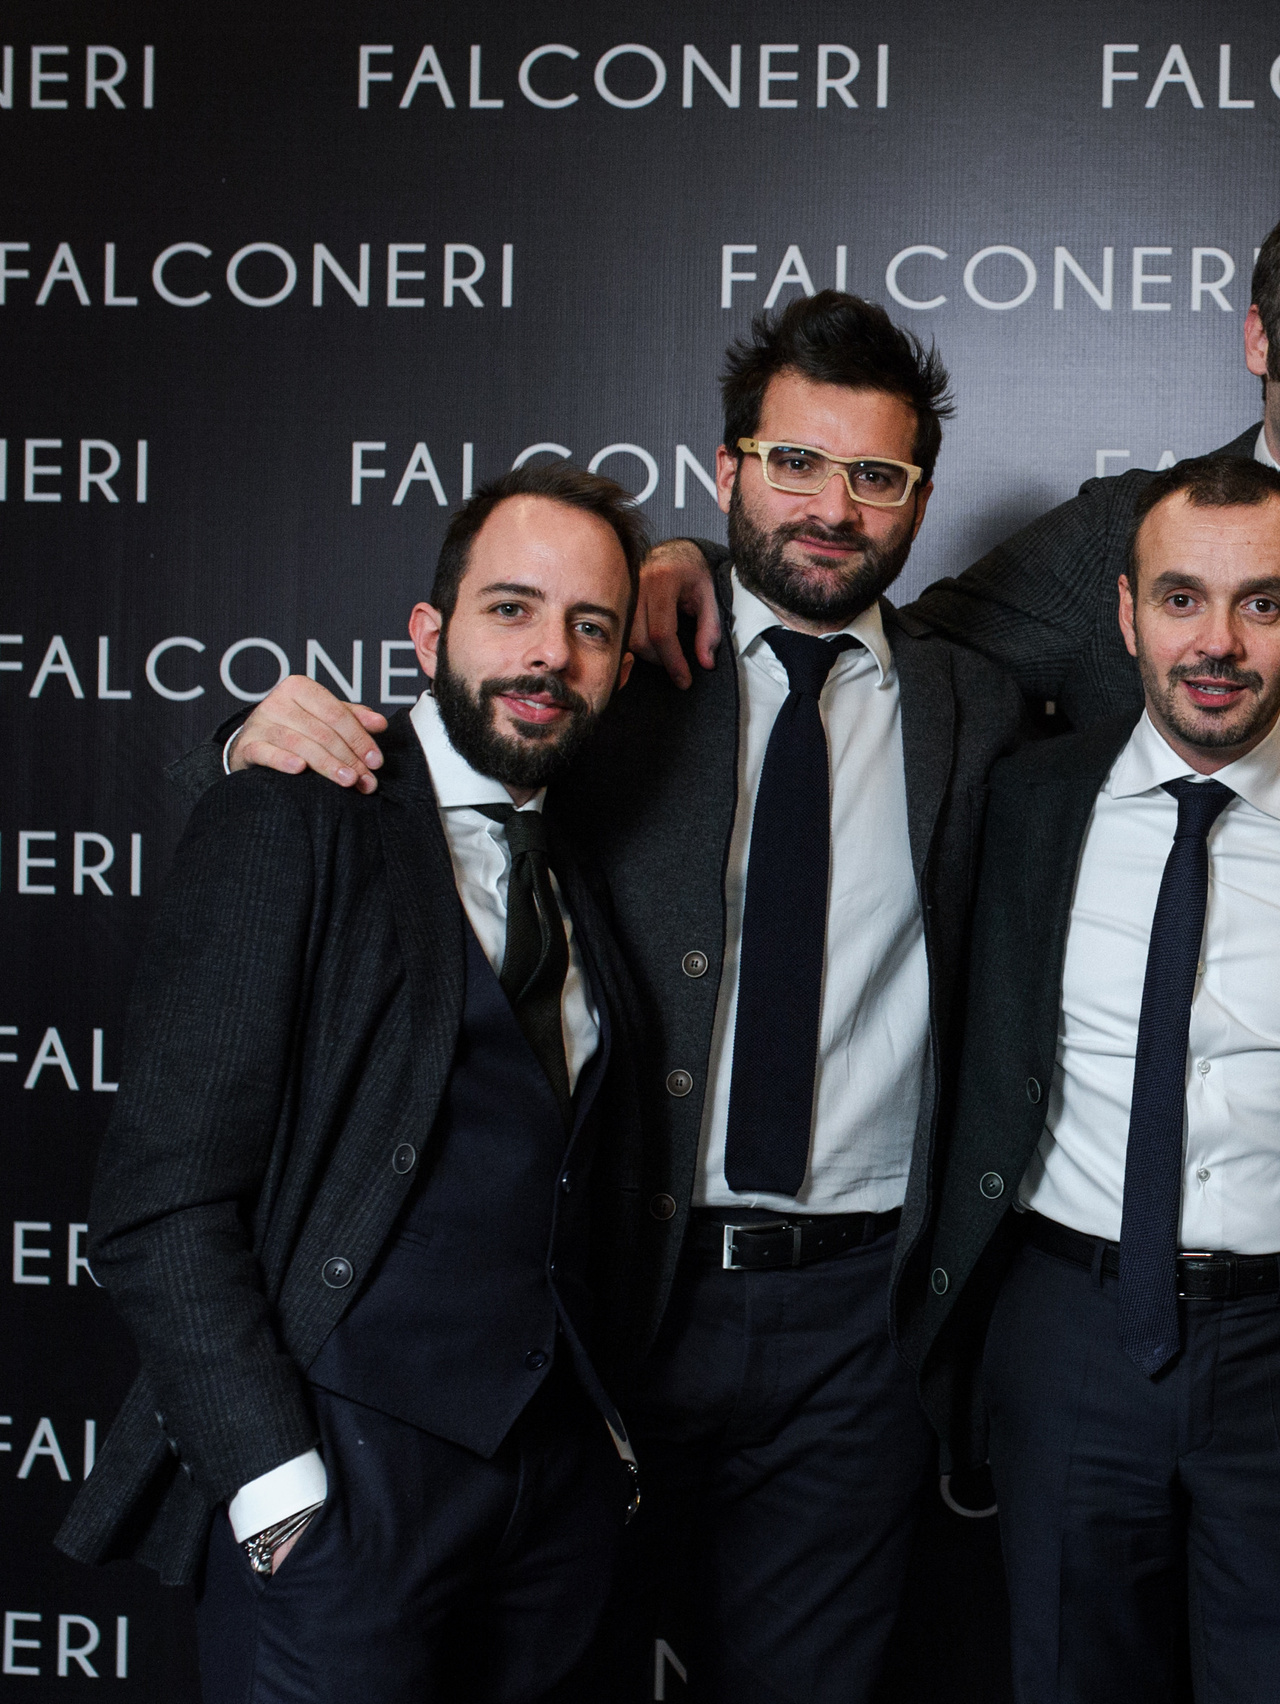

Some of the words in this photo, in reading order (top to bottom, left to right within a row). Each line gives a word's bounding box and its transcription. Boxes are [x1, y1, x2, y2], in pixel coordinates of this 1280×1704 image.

[0, 44, 155, 110] ERI
[358, 43, 890, 110] FALCONERI
[0, 241, 515, 309] FALCONERI
[720, 244, 1262, 312] FALCONER
[0, 438, 148, 504] ERI
[2, 1609, 130, 1680] ERI
